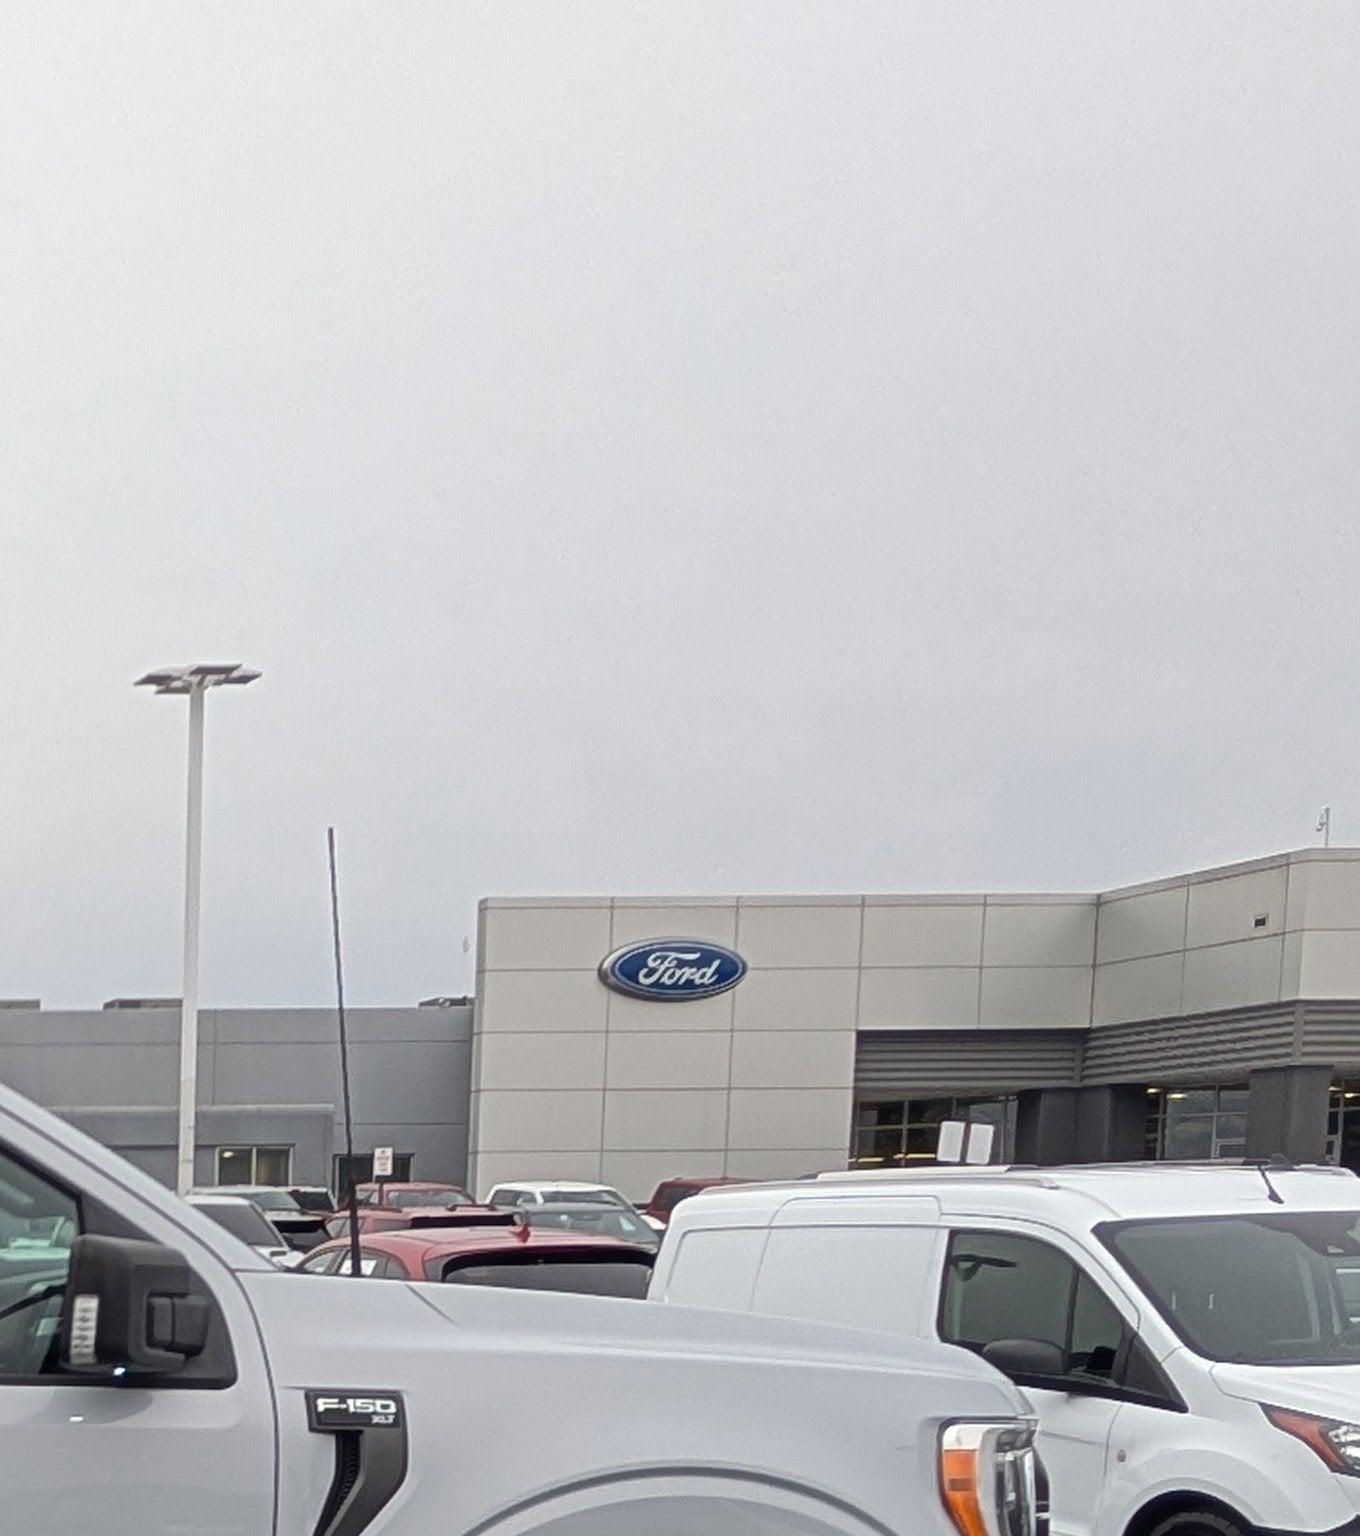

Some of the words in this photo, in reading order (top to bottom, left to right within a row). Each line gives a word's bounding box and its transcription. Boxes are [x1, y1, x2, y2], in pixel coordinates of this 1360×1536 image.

[638, 951, 721, 985] Ford
[316, 1398, 397, 1414] F-150
[371, 1414, 395, 1424] XLT
